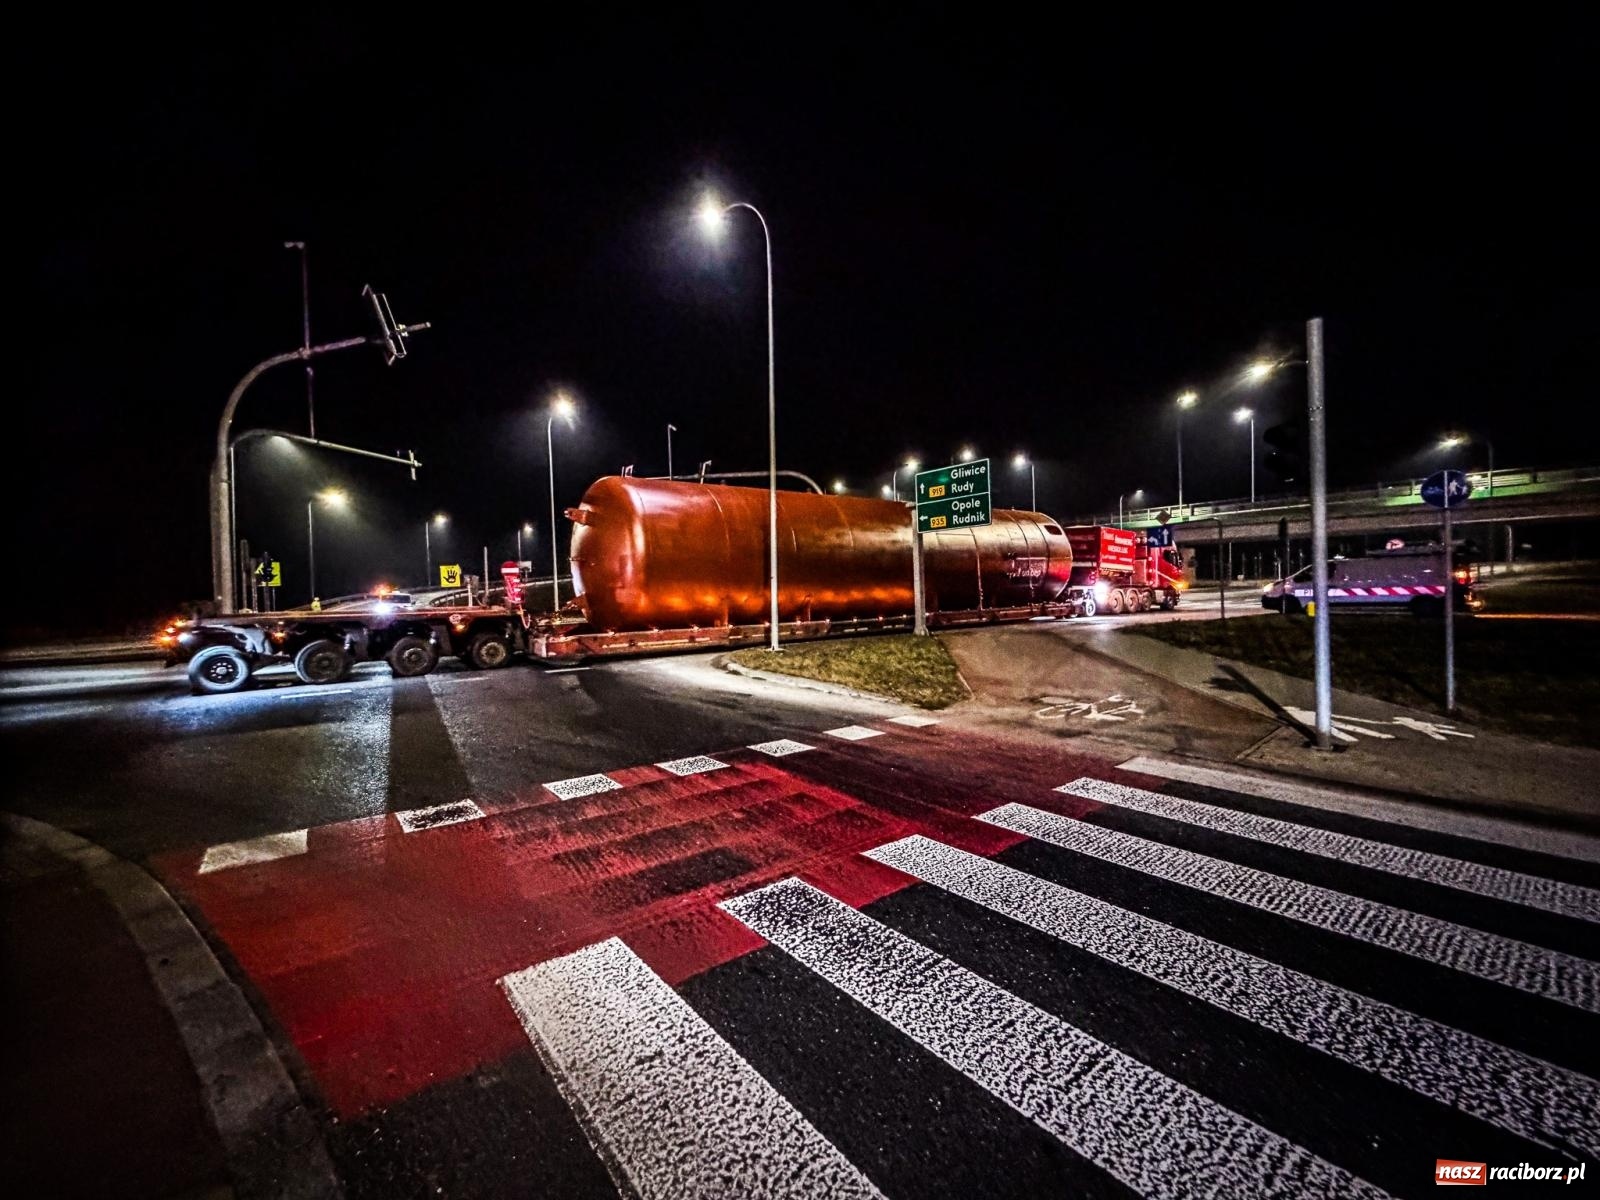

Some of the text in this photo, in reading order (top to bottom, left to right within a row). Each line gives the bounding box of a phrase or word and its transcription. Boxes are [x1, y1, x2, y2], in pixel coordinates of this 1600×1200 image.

[950, 465, 986, 479] Gliwice
[931, 487, 943, 496] 919
[951, 481, 974, 493] Rudy
[951, 498, 981, 512] Opole
[931, 517, 945, 527] 935
[952, 511, 986, 525] Rudnik
